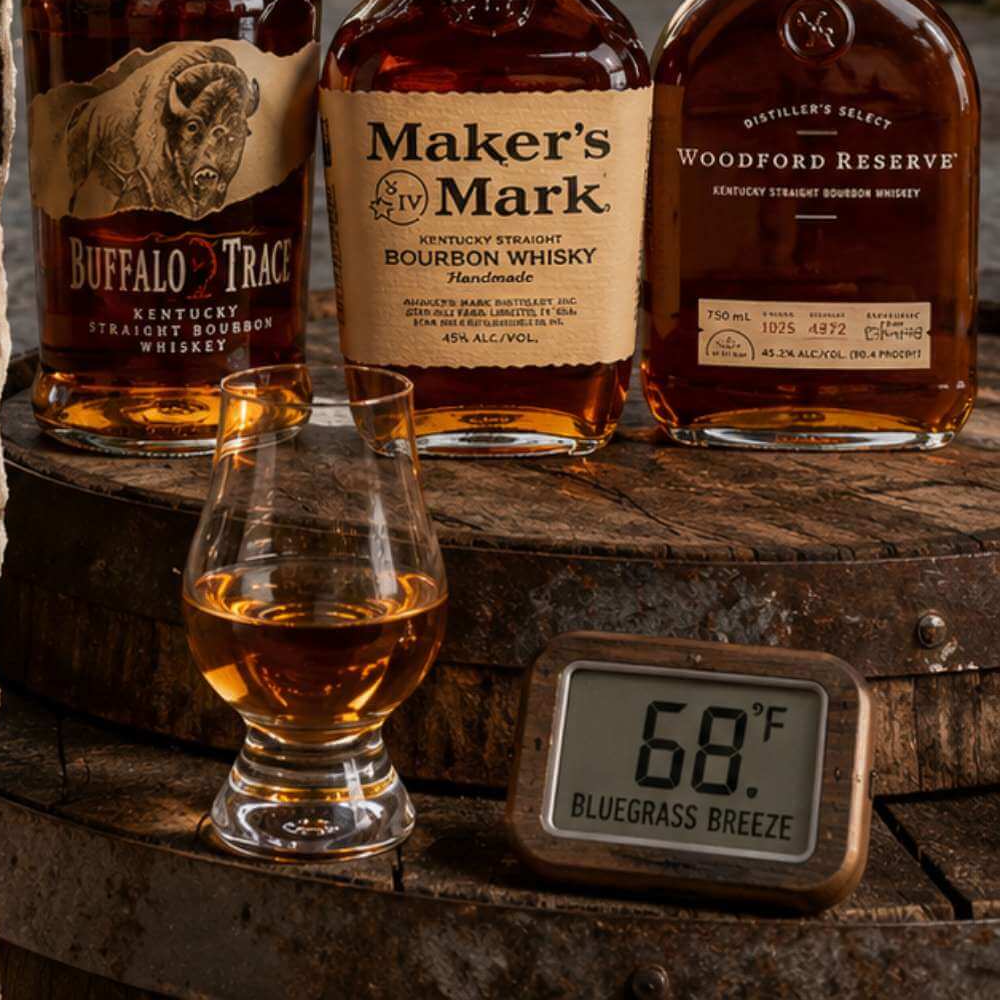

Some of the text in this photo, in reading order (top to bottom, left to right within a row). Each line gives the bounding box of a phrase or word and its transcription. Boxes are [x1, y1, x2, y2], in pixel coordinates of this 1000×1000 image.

[743, 103, 892, 130] DISTILLER'S SELECT
[366, 121, 611, 167] Maker's
[677, 147, 955, 170] WOODFORD RESERVE
[398, 175, 609, 217] IV Mark
[712, 186, 921, 199] KENTUCKY STRAIGHT BOURBON WHISKEY
[419, 234, 562, 245] KENTUCKY STRAIGHT
[69, 237, 292, 293] BUFFALO TRACE
[384, 247, 597, 267] BOURBON WHISKY
[446, 271, 534, 284] Handmade
[133, 304, 239, 320] KENTUCKY
[707, 310, 730, 322] 750
[732, 312, 751, 322] mL
[89, 317, 273, 337] STRAIGHT BOURBON
[140, 338, 227, 354] WHISKEY
[570, 793, 795, 841] BLUEGRASS BREEZE
